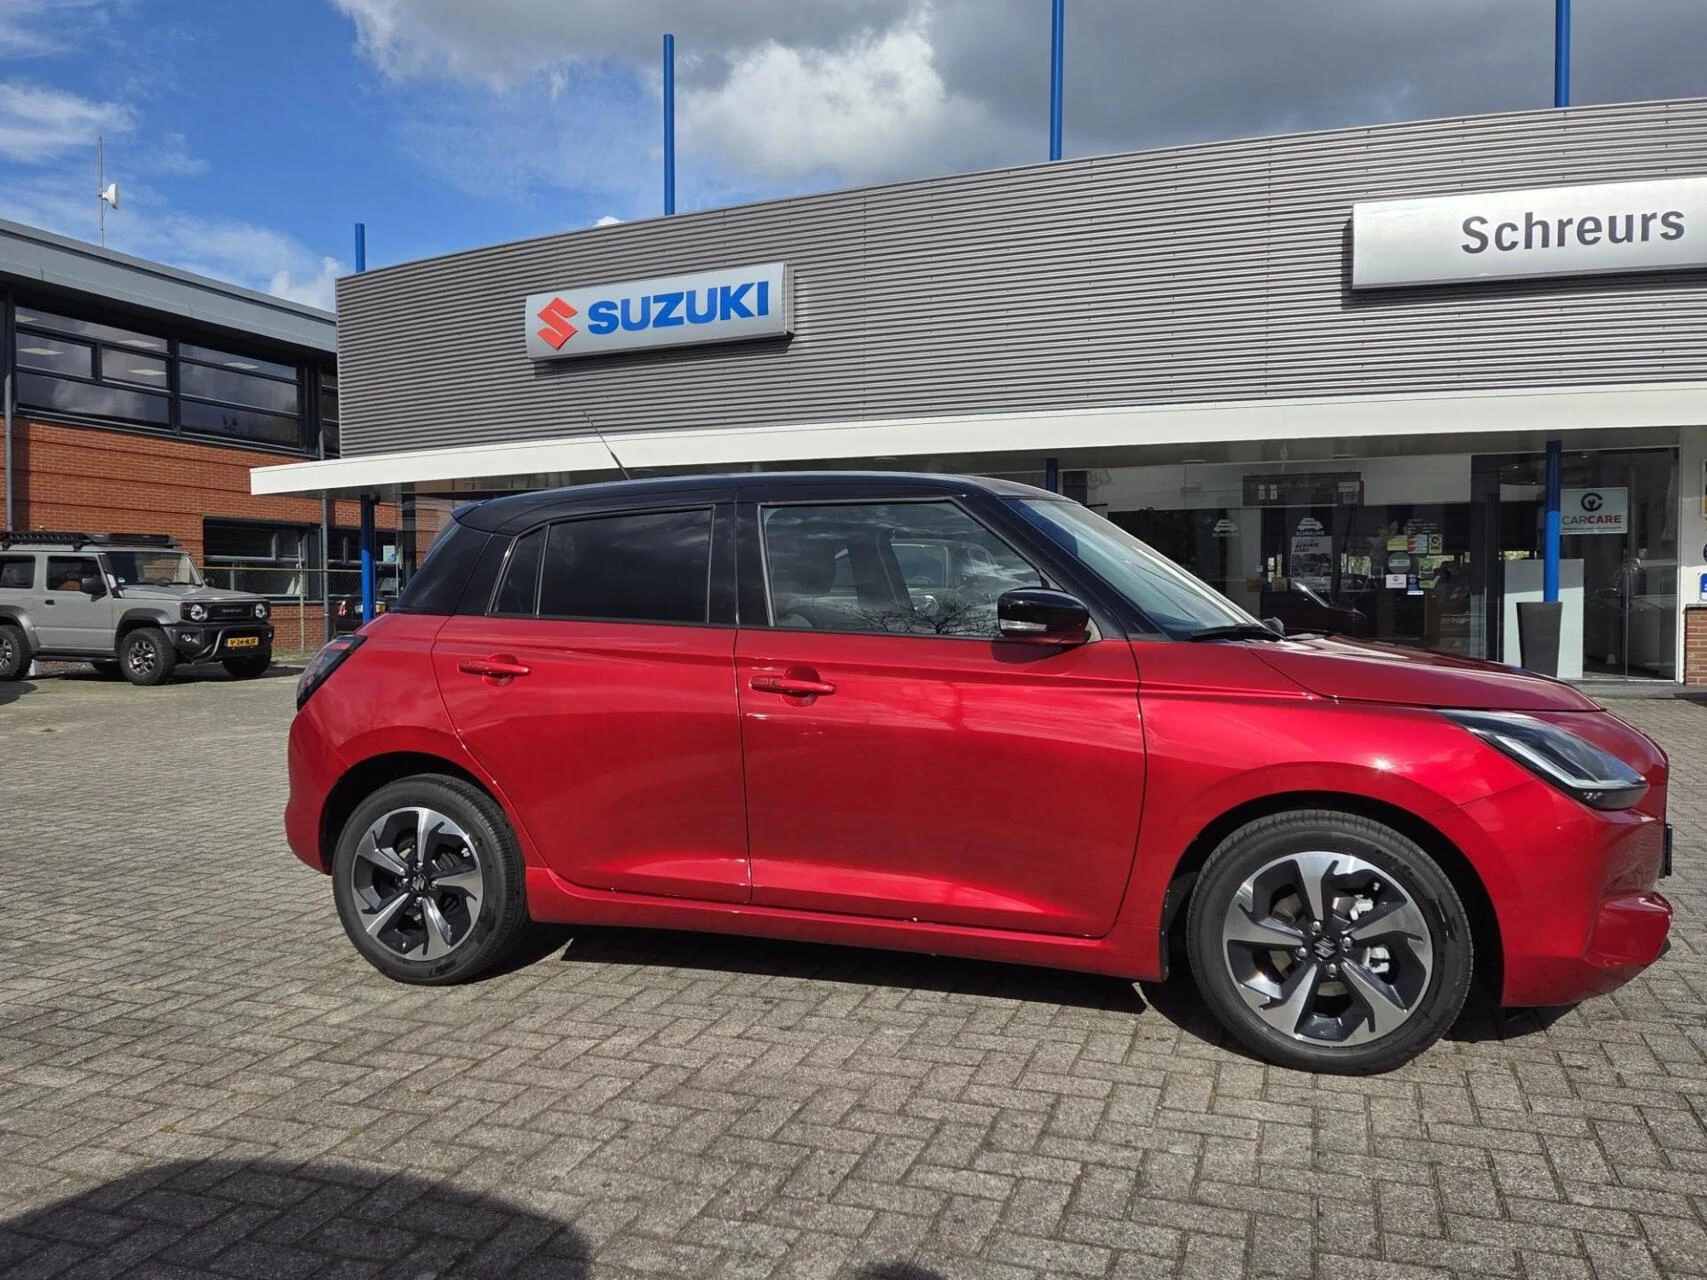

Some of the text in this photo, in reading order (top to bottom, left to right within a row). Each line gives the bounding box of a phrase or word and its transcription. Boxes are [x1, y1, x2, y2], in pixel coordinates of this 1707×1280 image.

[1461, 210, 1685, 254] Schreurs
[587, 280, 769, 335] SUZUKI
[1562, 514, 1622, 525] CARCARE
